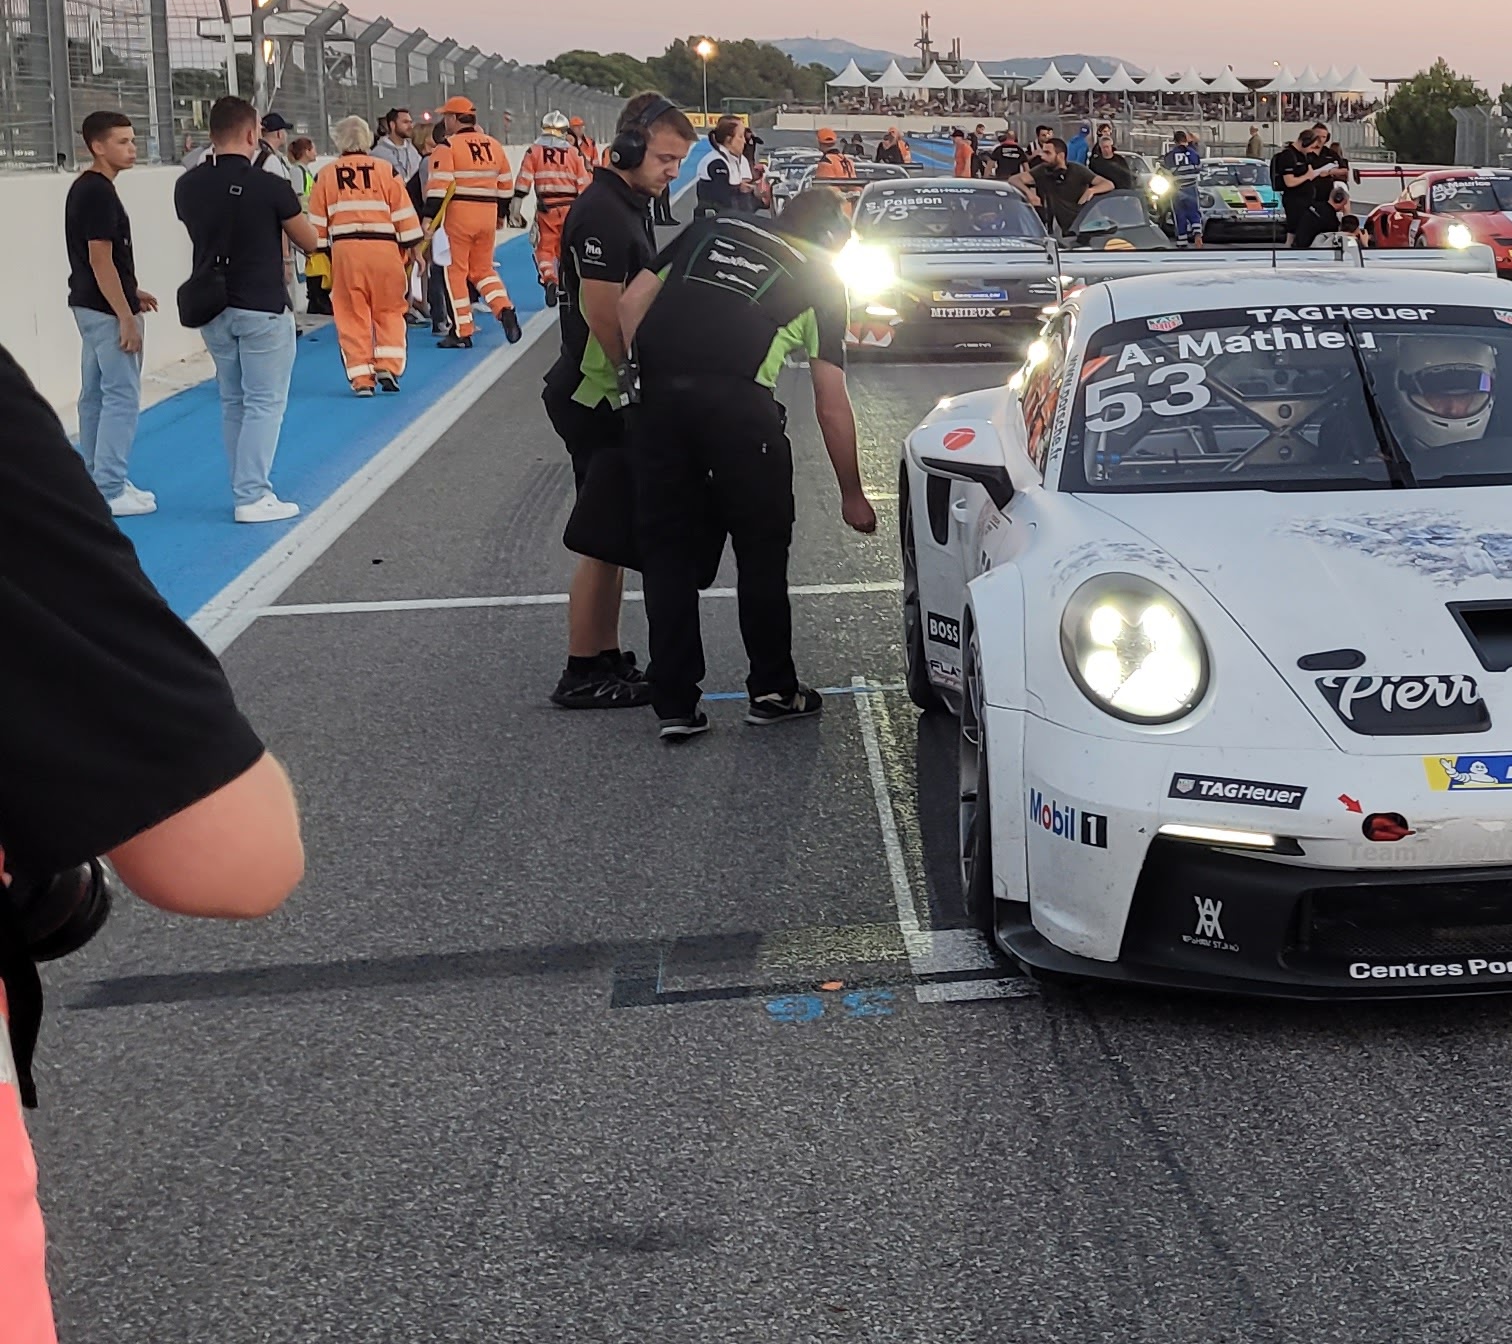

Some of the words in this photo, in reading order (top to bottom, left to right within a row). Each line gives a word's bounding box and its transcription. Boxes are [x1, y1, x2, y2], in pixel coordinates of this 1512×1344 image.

[467, 142, 493, 162] RT
[542, 146, 568, 165] RT
[335, 166, 375, 190] RT
[884, 197, 942, 208] Poisson
[931, 307, 996, 318] MITHIEUX
[1116, 343, 1165, 373] A.
[1178, 327, 1375, 360] Mathieu
[1050, 355, 1079, 462] www.porsche.fr
[1084, 362, 1212, 434] 53
[929, 618, 959, 643] BOSS
[930, 659, 961, 678] FLA
[1322, 674, 1483, 721] Pierr
[1030, 787, 1075, 842] Mobil
[1349, 960, 1464, 980] Centres
